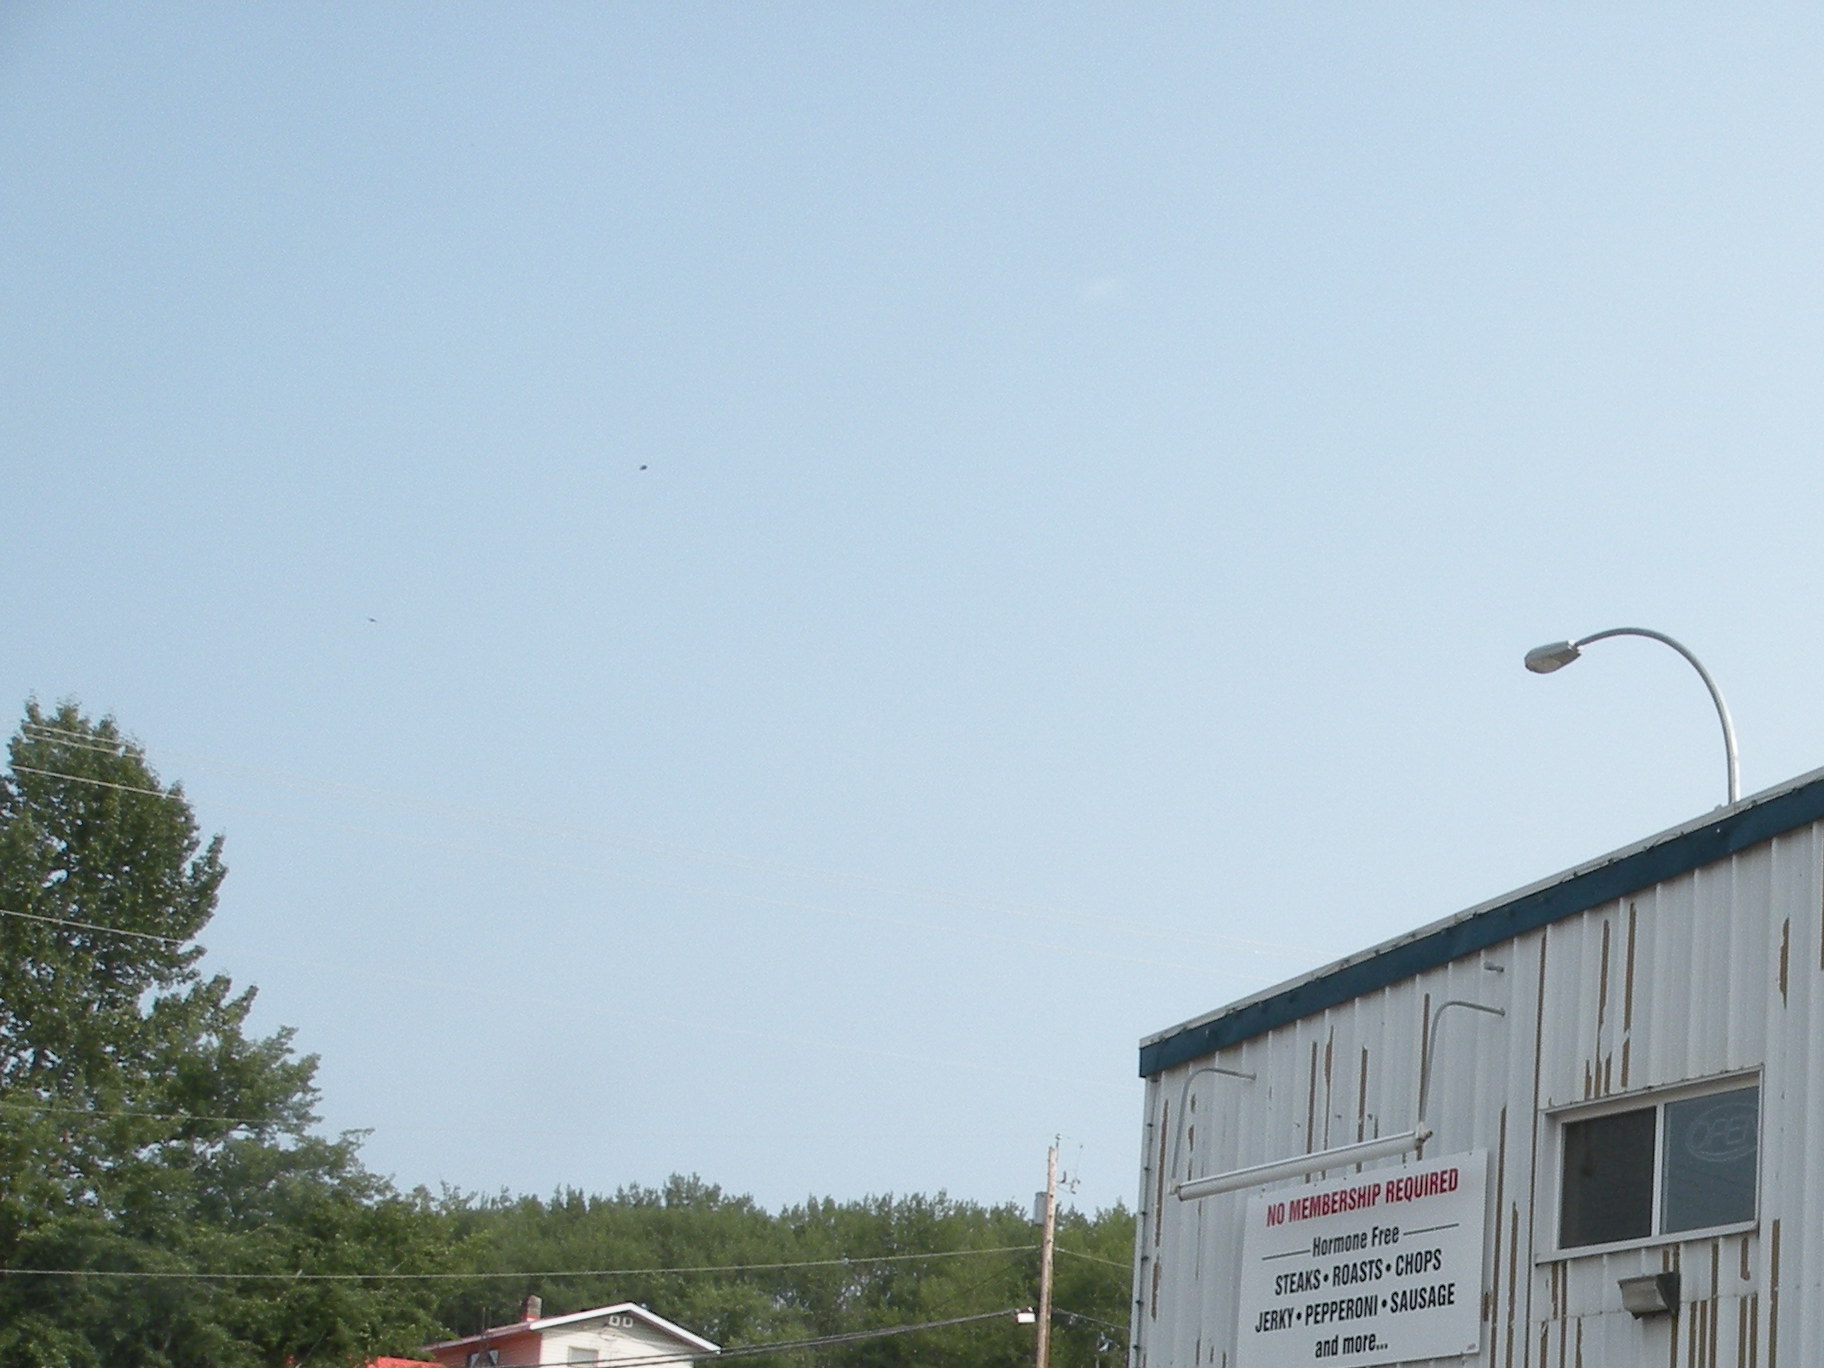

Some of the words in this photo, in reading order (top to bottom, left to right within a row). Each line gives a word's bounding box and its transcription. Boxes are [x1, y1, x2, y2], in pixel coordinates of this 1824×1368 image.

[1266, 1202, 1286, 1228] NO
[1288, 1182, 1382, 1223] MEMBERSHIP
[1385, 1167, 1460, 1204] REQUIRED
[1312, 1232, 1368, 1257] Hormone
[1371, 1225, 1401, 1247] Free
[1274, 1269, 1321, 1296] STEAKS
[1332, 1258, 1384, 1288] ROASTS
[1395, 1248, 1443, 1277] CHOPS
[1255, 1306, 1297, 1334] JERKY
[1304, 1294, 1379, 1327] PEPPERONI
[1389, 1282, 1456, 1314] SAUSAGE
[1314, 1334, 1340, 1359] and
[1342, 1332, 1389, 1355] more...
